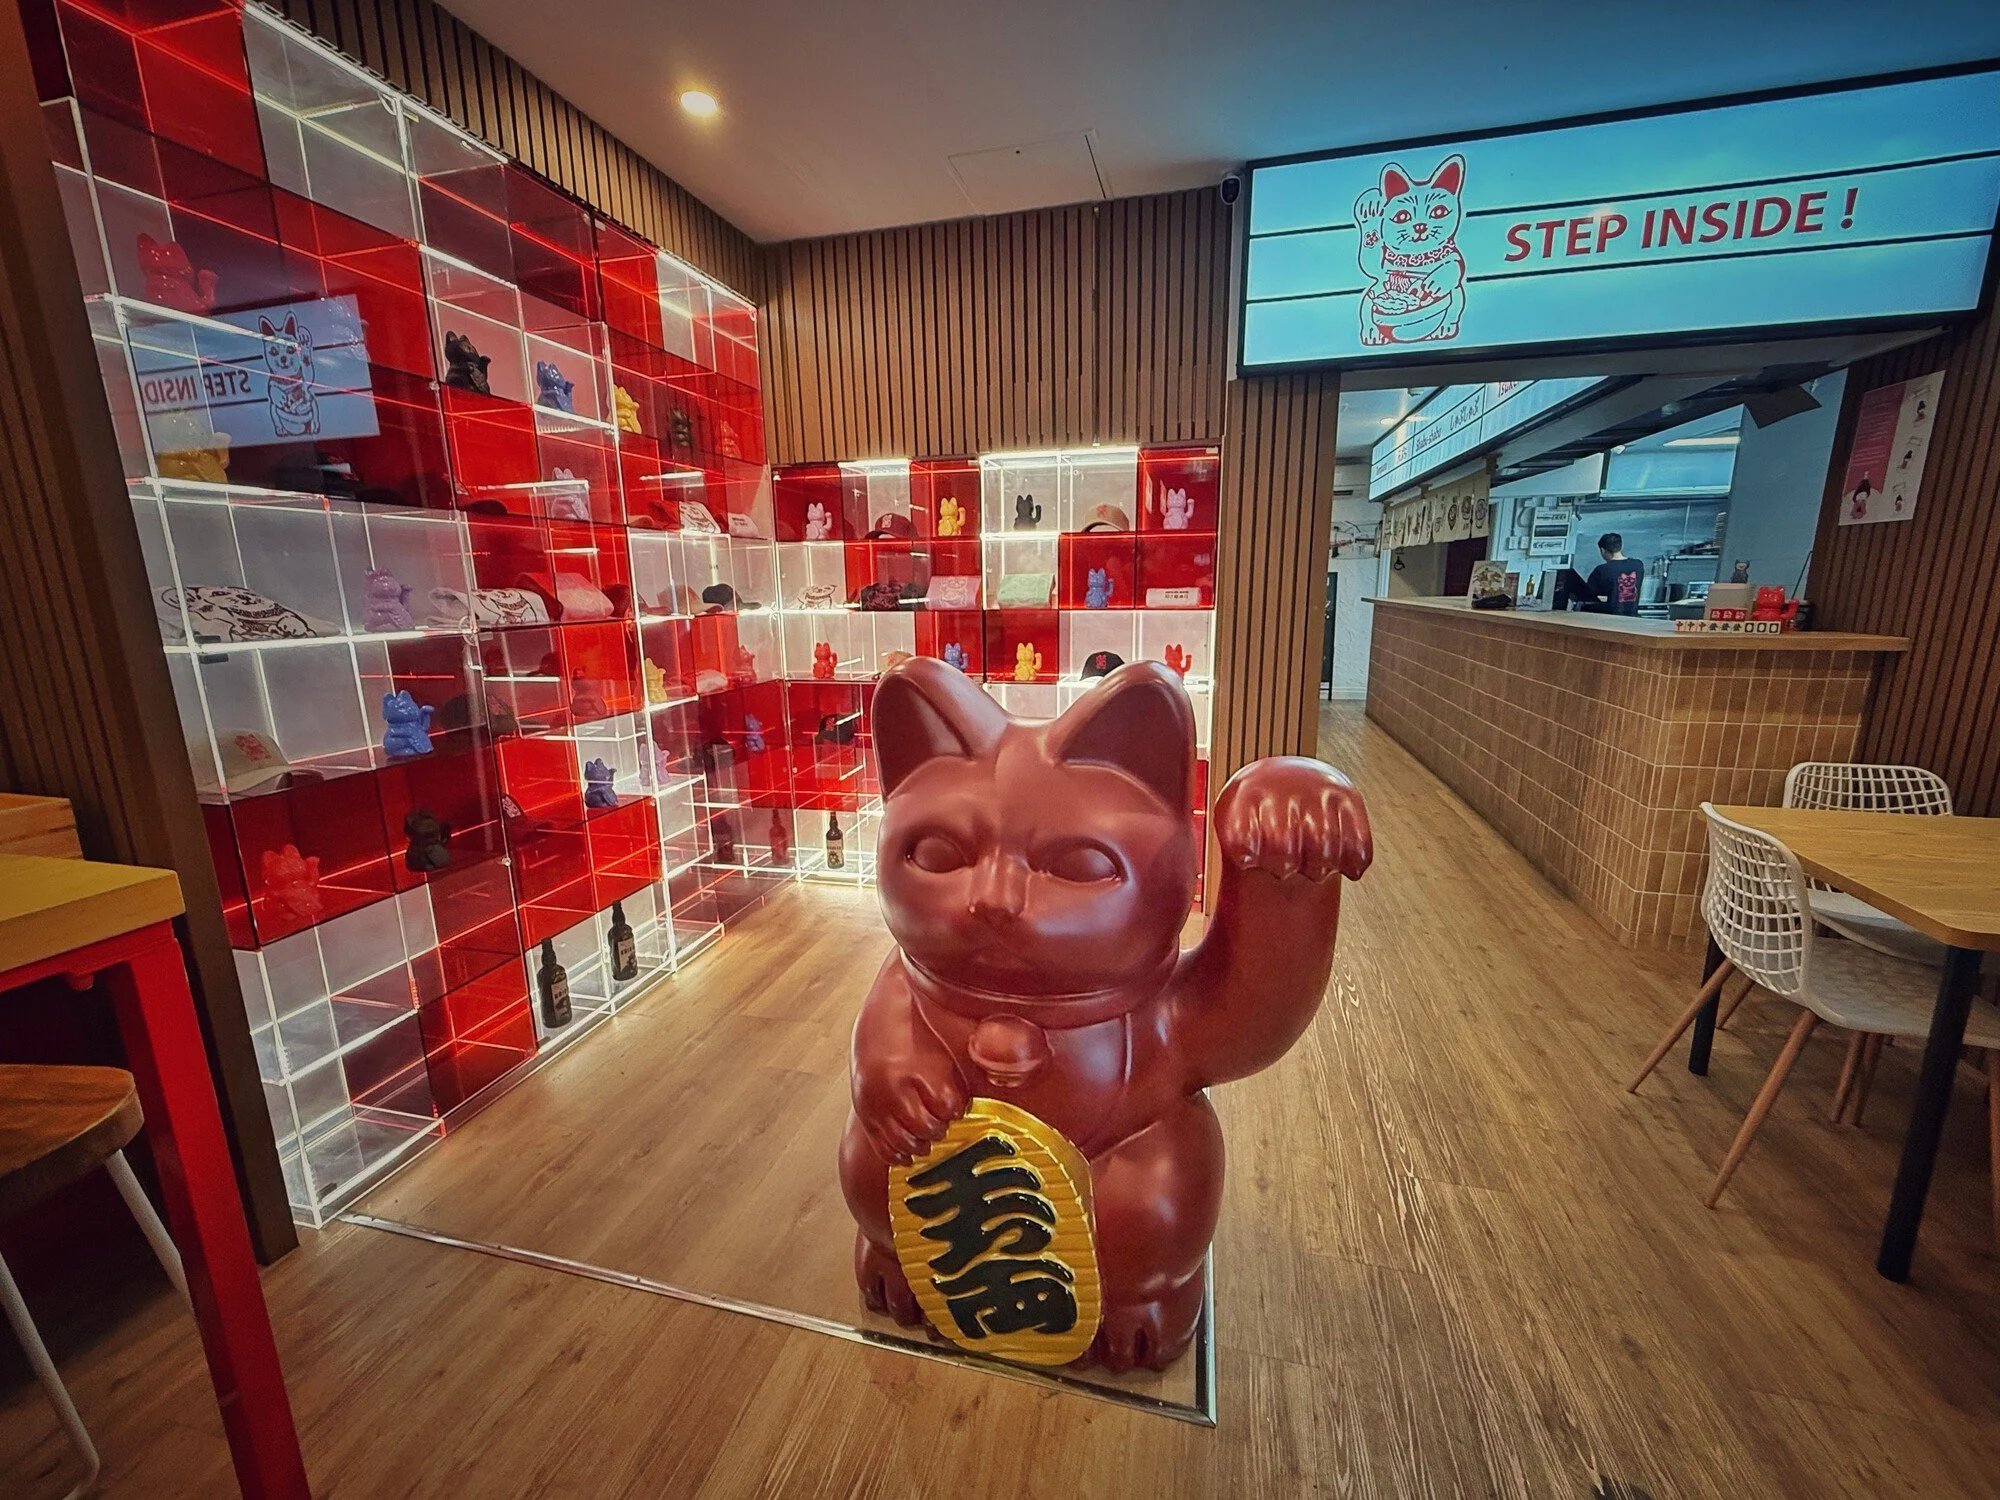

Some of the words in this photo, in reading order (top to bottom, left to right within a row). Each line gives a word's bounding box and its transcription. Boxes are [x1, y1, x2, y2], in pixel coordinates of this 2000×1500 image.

[1504, 213, 1628, 262] STEP
[1641, 190, 1828, 249] INSIDE
[1840, 187, 1859, 230] !
